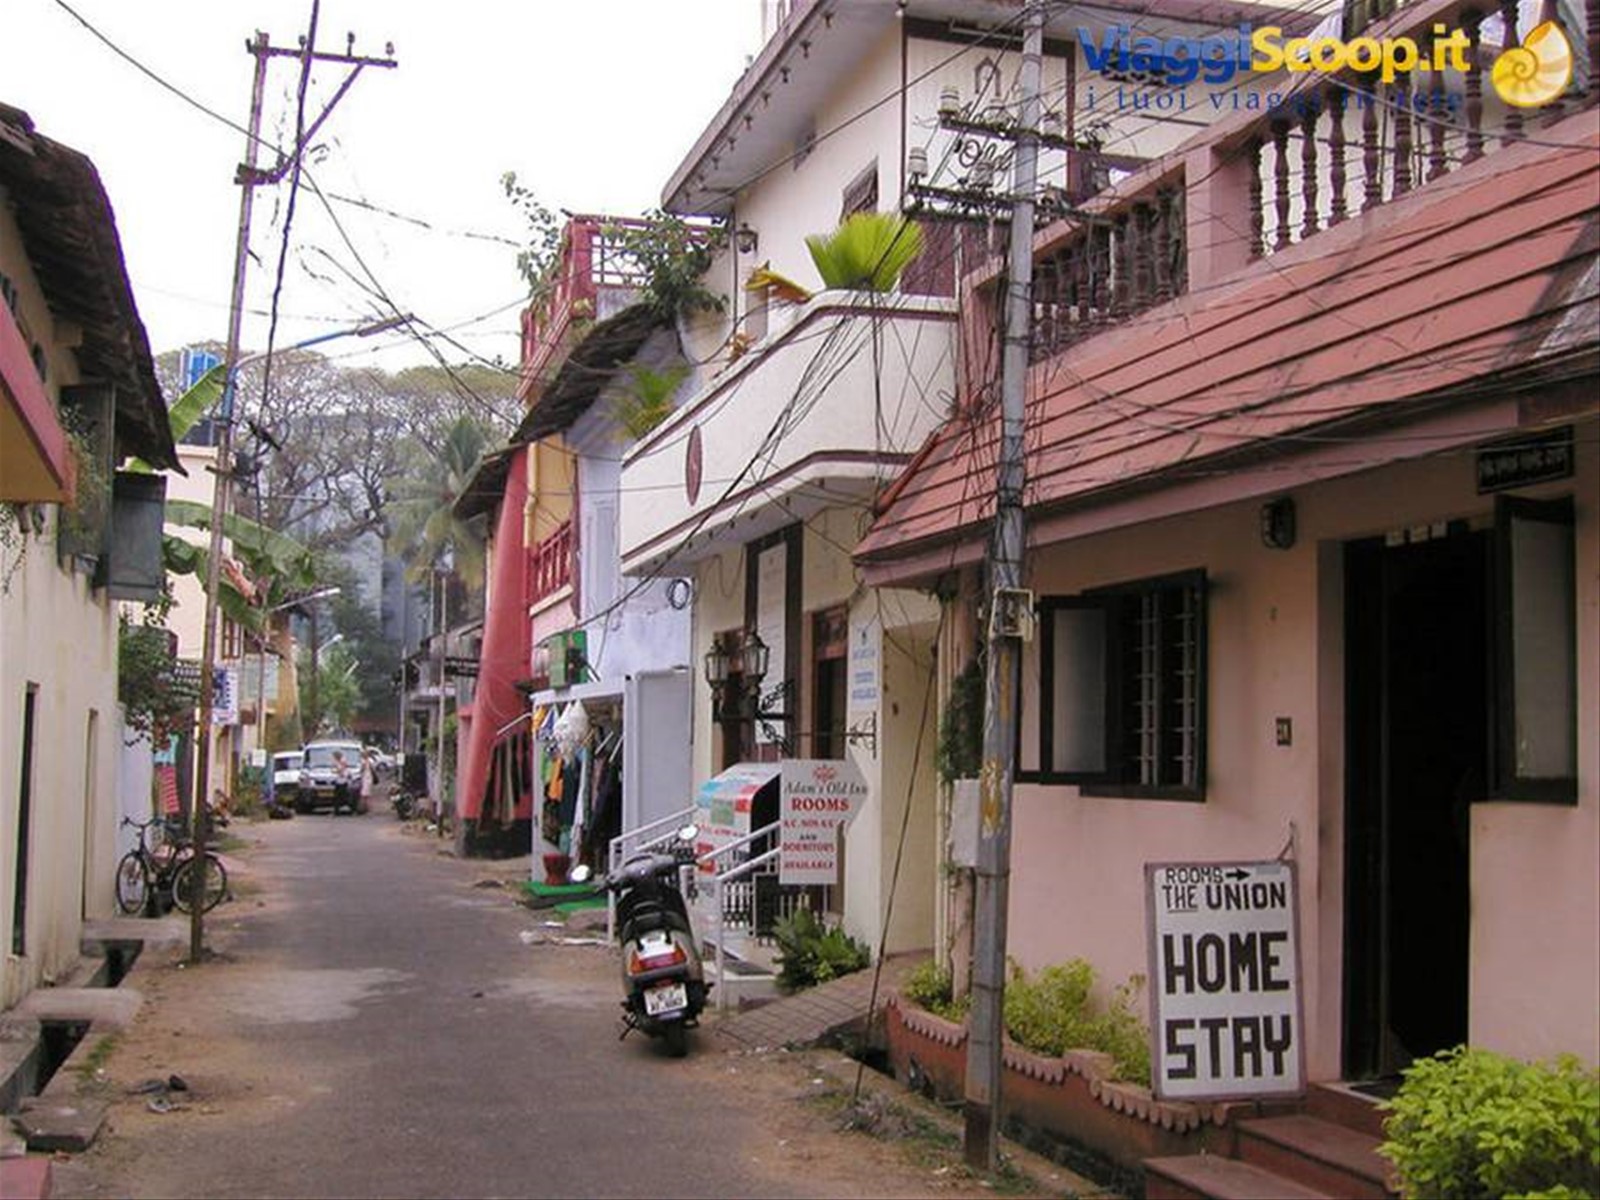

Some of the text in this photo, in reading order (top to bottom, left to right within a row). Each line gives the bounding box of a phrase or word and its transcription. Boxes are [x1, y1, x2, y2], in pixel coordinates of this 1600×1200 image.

[792, 797, 850, 811] ROOMS
[1165, 866, 1224, 884] ROOMS
[1161, 881, 1286, 911] THE UNION
[1162, 931, 1291, 995] HOME
[1165, 1015, 1292, 1080] STAY
